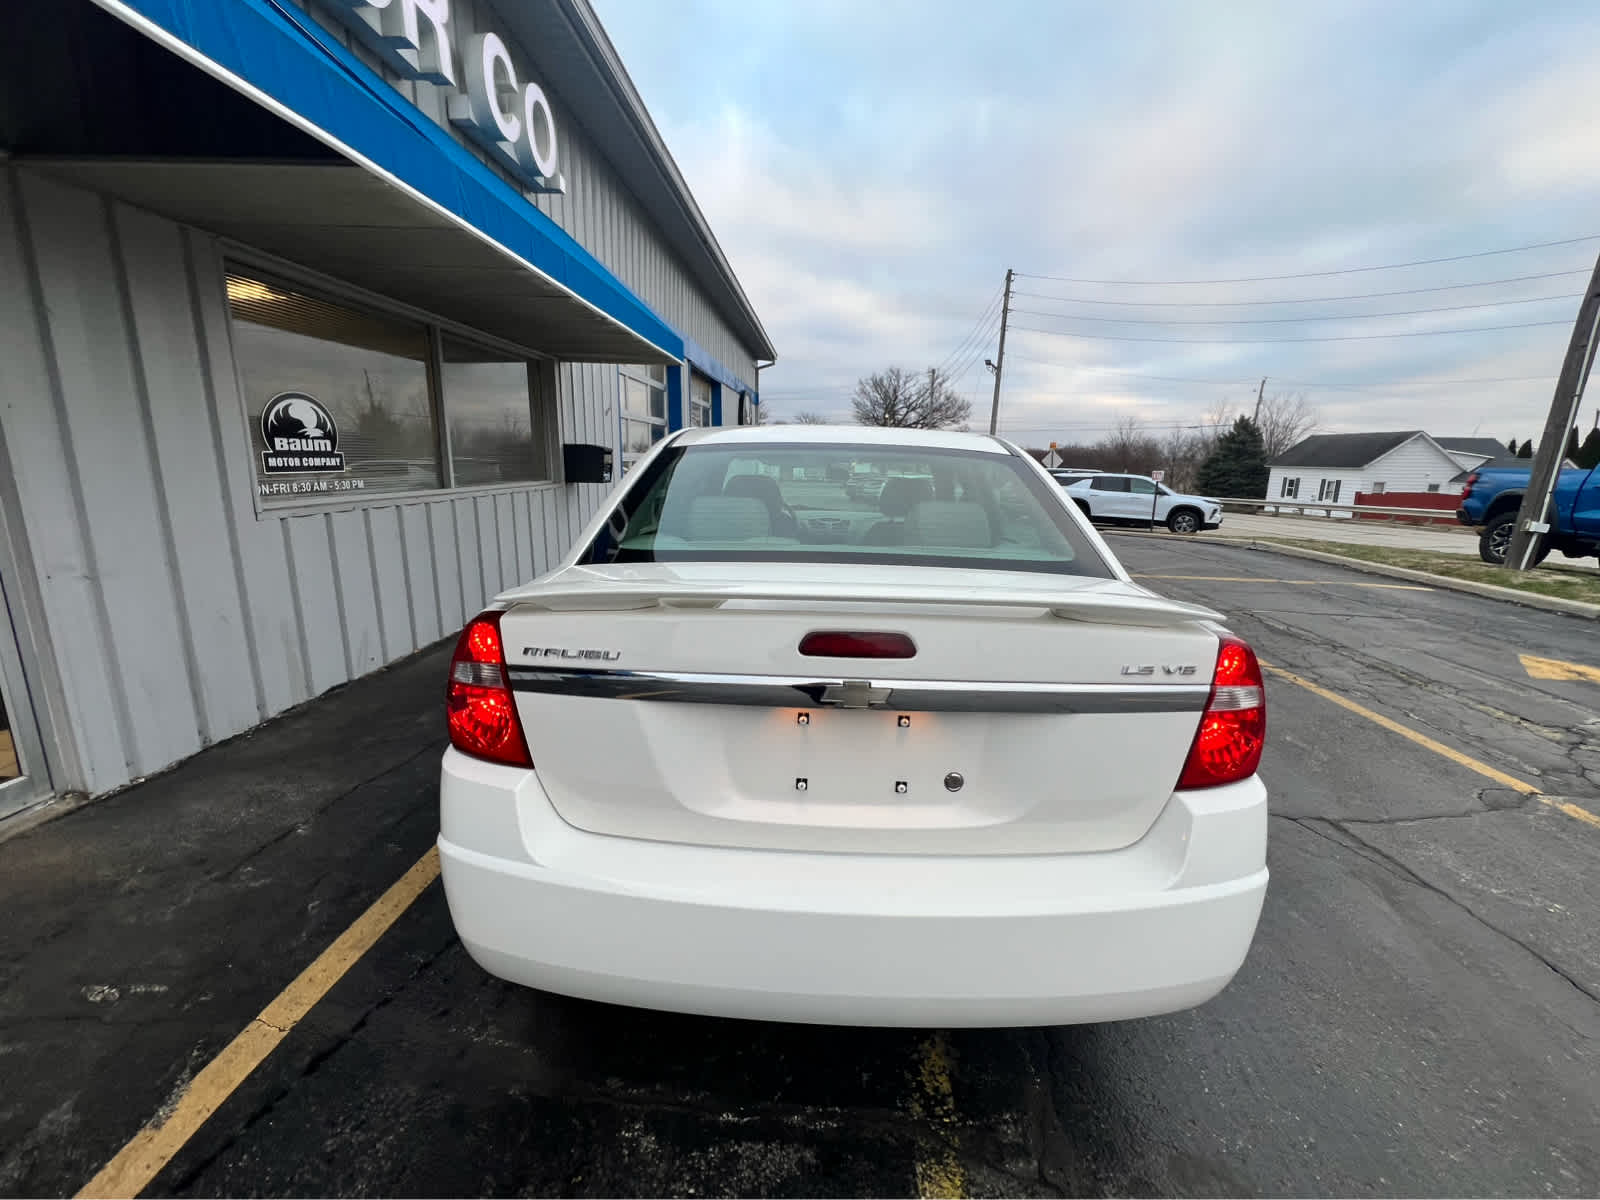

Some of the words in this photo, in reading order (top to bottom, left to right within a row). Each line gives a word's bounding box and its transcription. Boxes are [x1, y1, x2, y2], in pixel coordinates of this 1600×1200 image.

[365, 0, 456, 87] R
[274, 437, 332, 452] Baum
[268, 457, 300, 467] MOTOR
[302, 457, 341, 467] COMPANY
[313, 481, 328, 491] AM
[334, 480, 351, 490] 5:30
[352, 479, 365, 489] PM
[522, 646, 621, 661] MALIBU
[1161, 664, 1197, 676] V6
